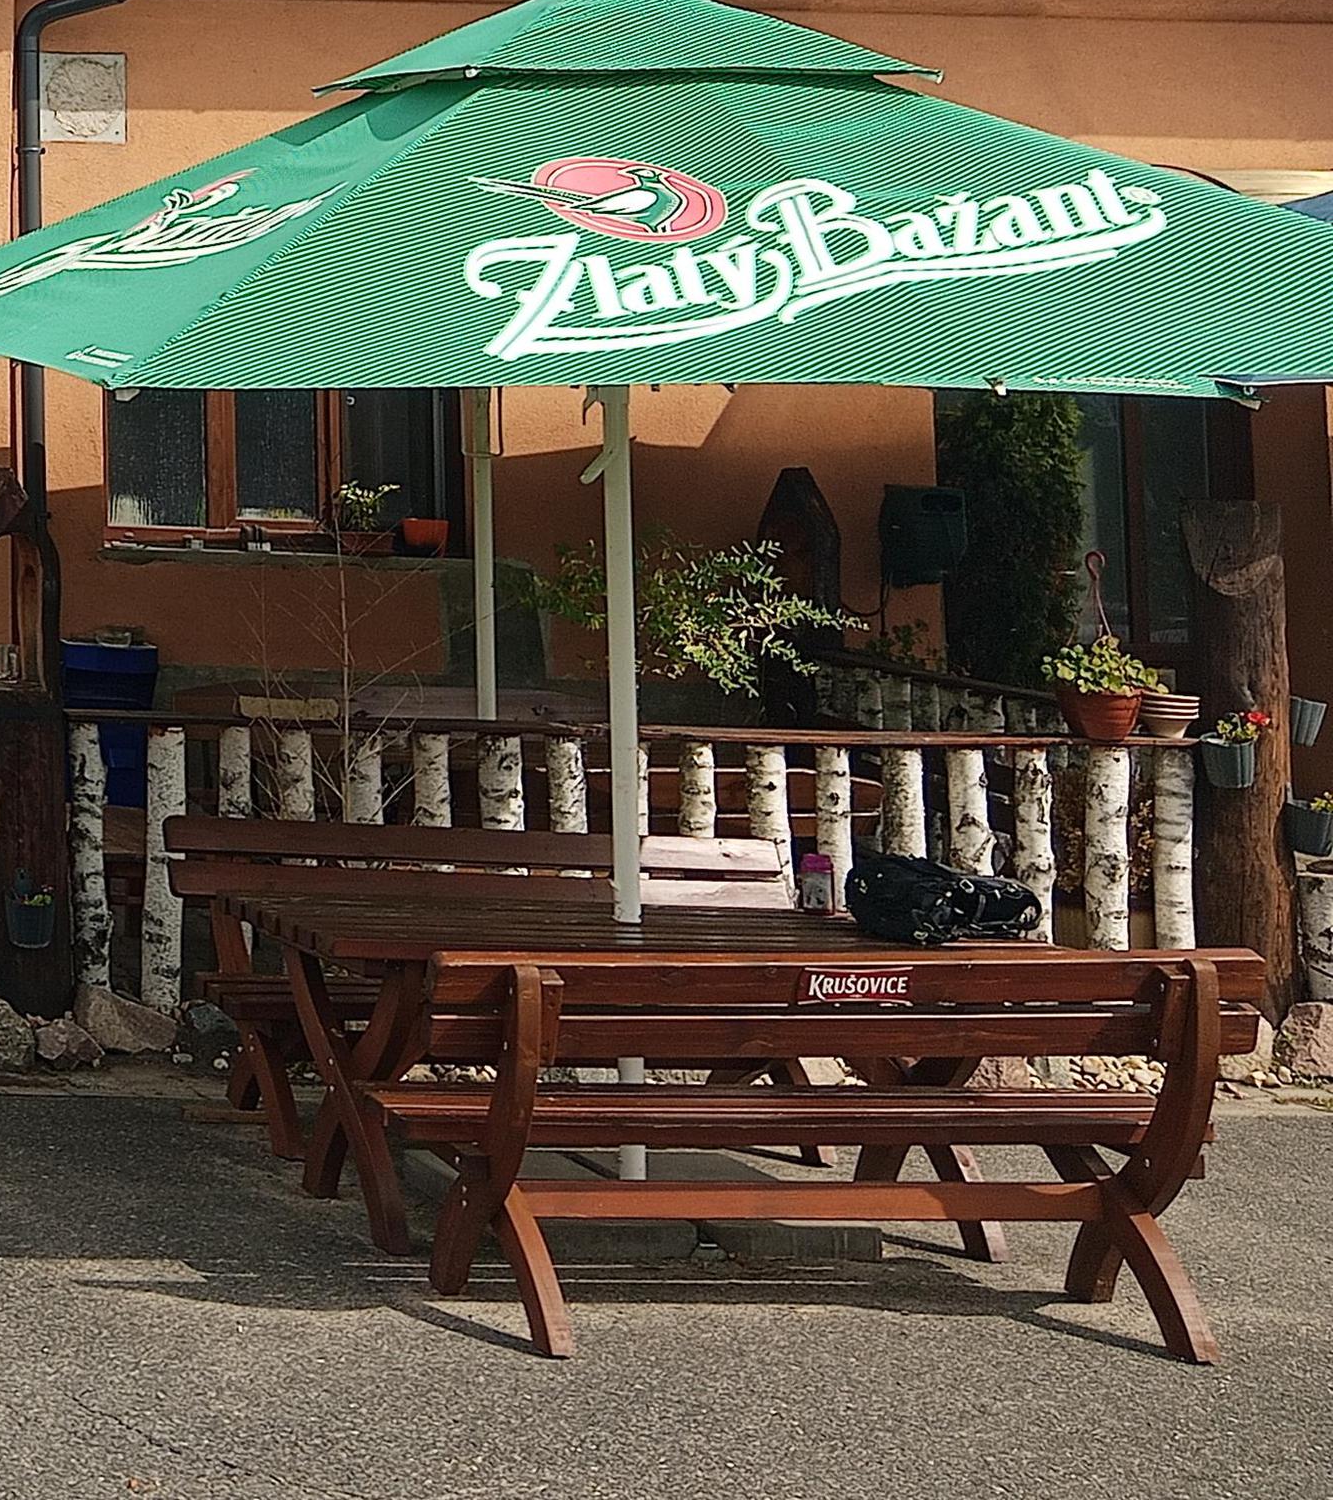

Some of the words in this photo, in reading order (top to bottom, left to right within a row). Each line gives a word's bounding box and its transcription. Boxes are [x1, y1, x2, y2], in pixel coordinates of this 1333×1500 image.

[463, 232, 793, 362] Zlatý
[746, 168, 1168, 300] Bažant
[808, 972, 909, 1001] KRUŠOVICE
